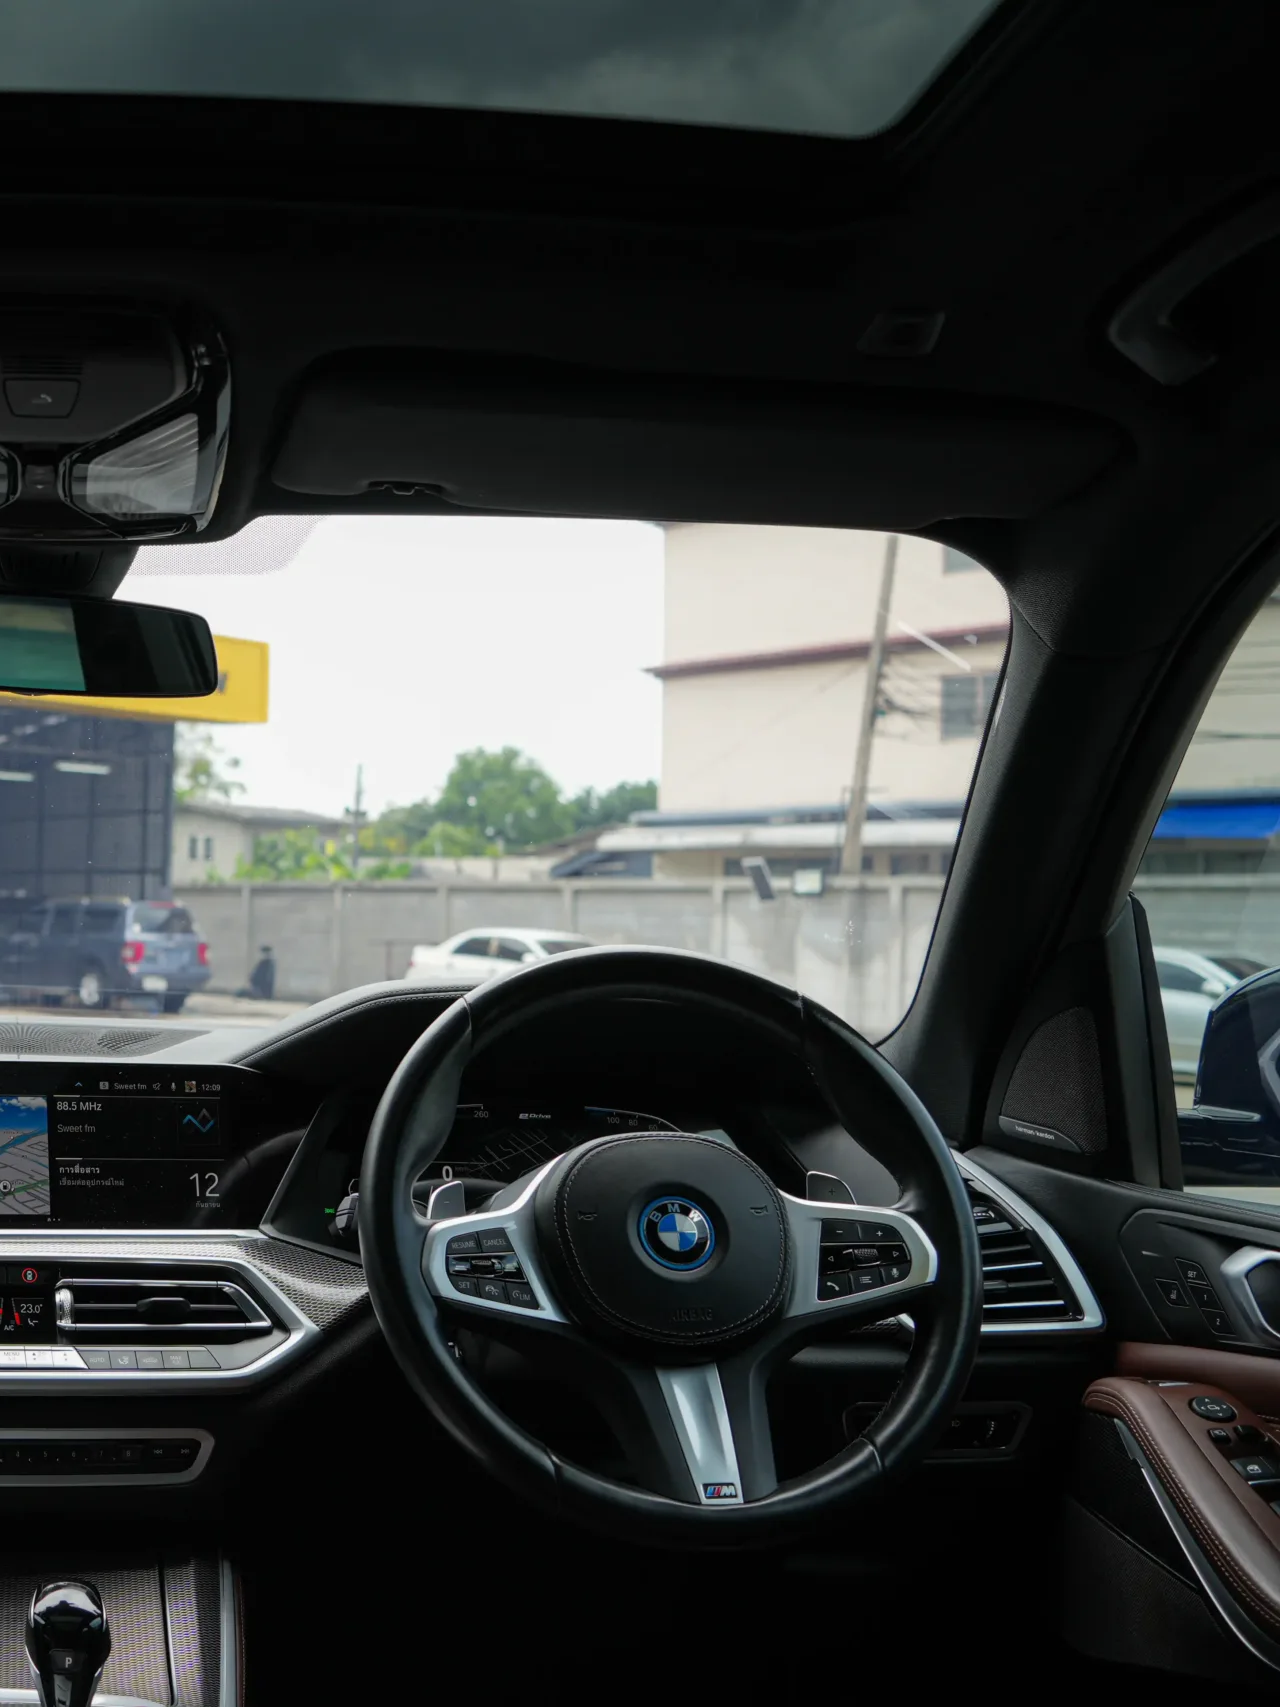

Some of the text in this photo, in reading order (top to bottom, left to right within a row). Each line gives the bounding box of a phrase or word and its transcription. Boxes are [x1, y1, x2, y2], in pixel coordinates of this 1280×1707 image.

[113, 1082, 136, 1090] Sweet
[137, 1082, 147, 1090] fm
[201, 1083, 221, 1092] 12:09
[56, 1101, 102, 1111] 88.5 MHz
[473, 1110, 489, 1119] 260
[606, 1116, 620, 1125] 100
[628, 1119, 638, 1127] 80
[57, 1123, 96, 1133] Sweet fm
[442, 1165, 453, 1182] 0
[189, 1172, 220, 1197] 12
[649, 1203, 702, 1223] BMW
[451, 1240, 476, 1250] RESUME
[1187, 1270, 1197, 1278] SET
[458, 1281, 470, 1289] SET
[519, 1292, 531, 1301] LIM
[65, 1657, 73, 1668] P
